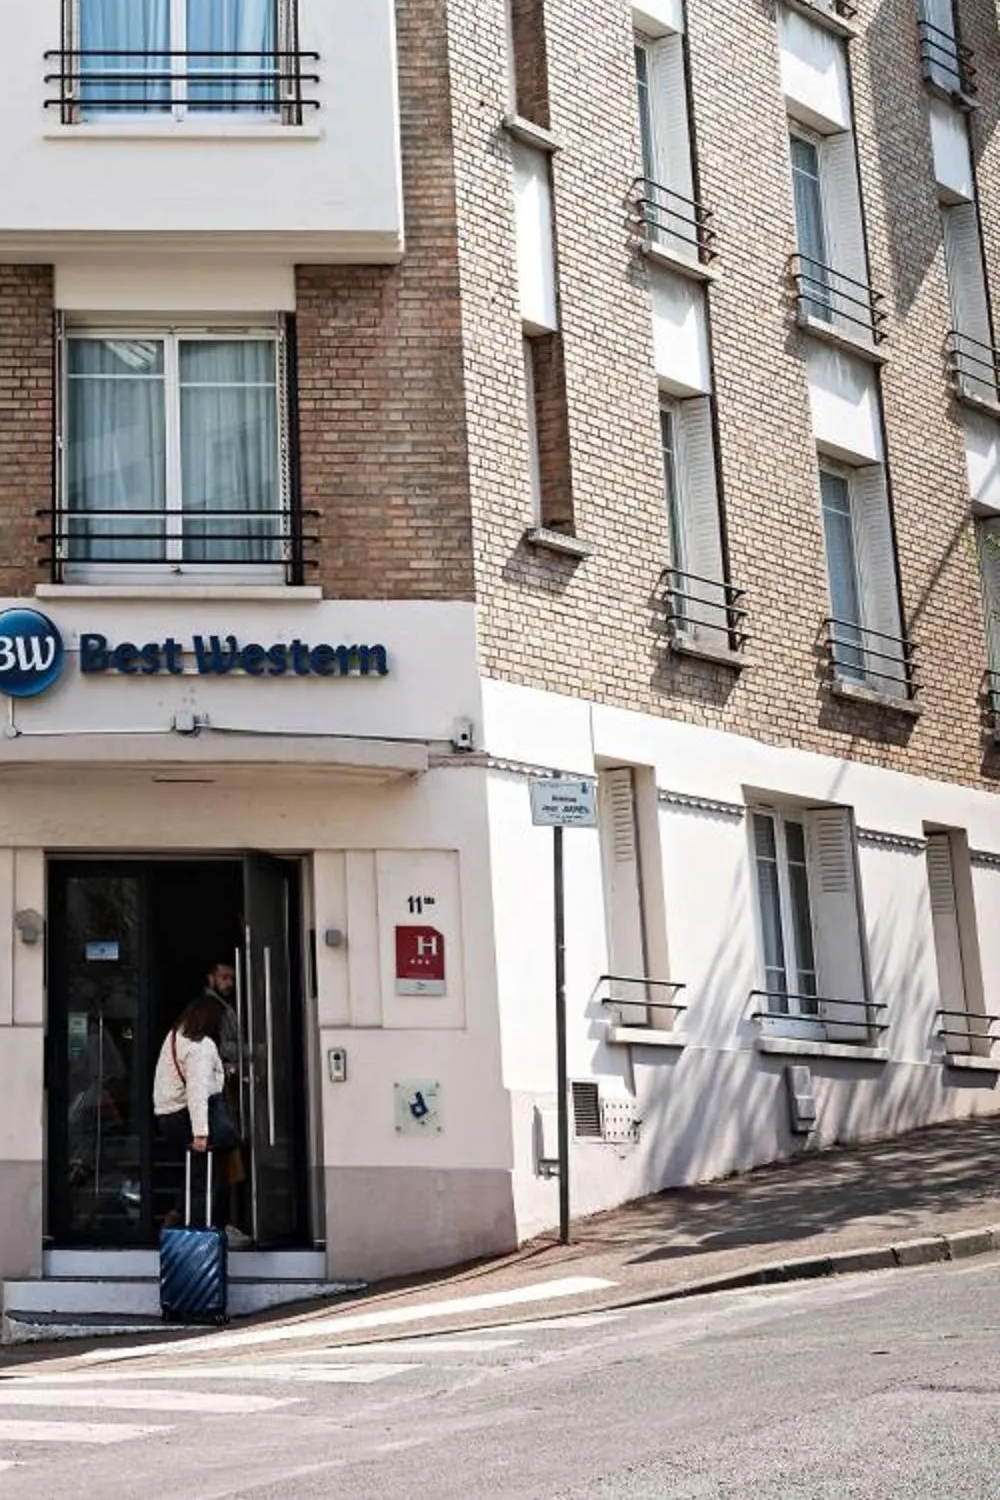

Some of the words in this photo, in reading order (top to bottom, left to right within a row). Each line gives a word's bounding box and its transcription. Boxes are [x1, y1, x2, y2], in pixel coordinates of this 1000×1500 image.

[79, 633, 185, 676] Best
[193, 633, 389, 677] Western
[417, 935, 438, 956] H
